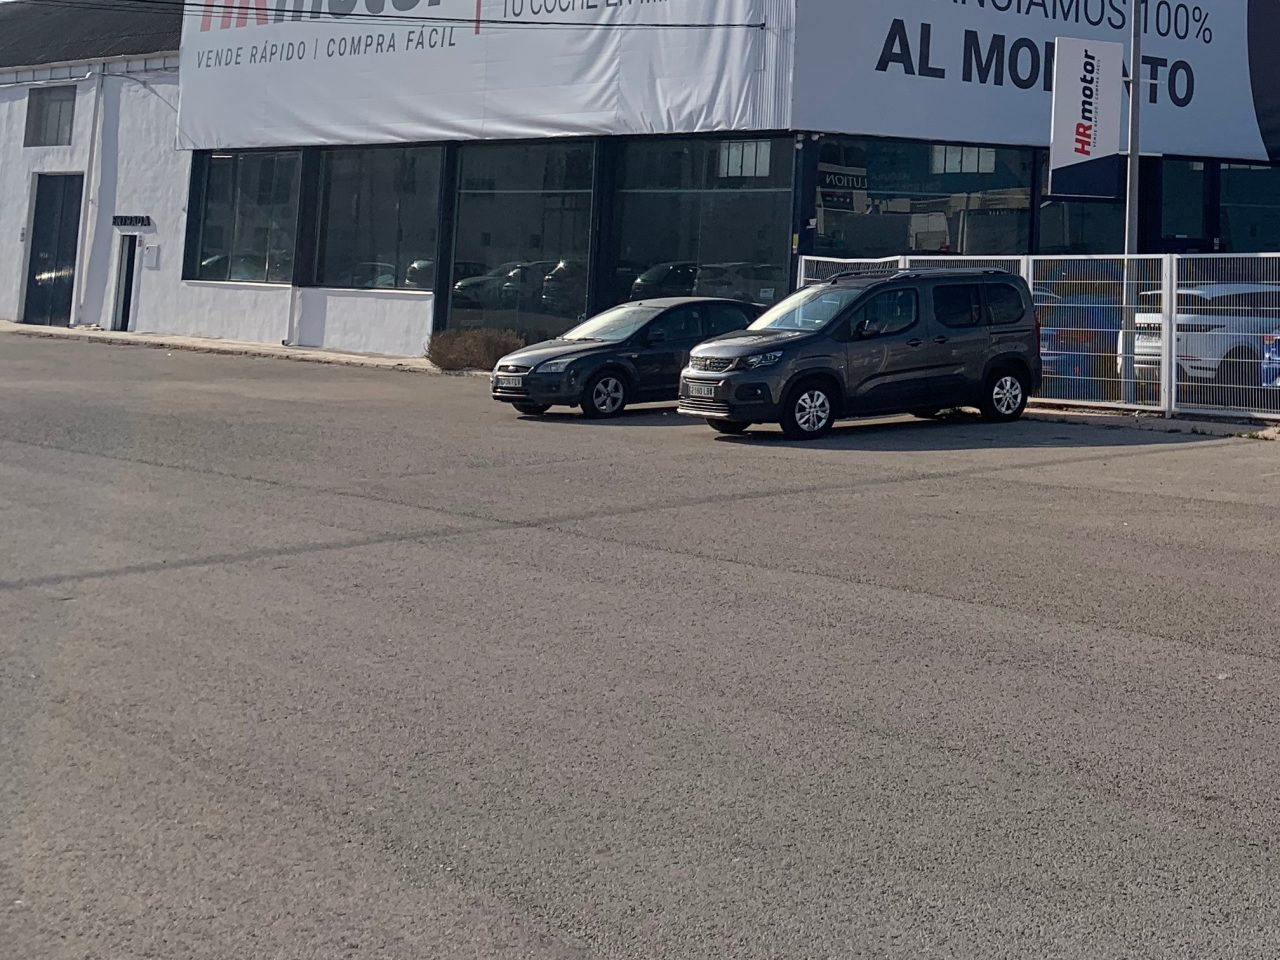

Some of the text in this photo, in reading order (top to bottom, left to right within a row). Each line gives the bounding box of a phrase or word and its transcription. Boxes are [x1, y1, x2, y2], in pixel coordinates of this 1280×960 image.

[197, 24, 456, 69] VENDE RÁPIDO COMPRA FÁCIL
[875, 18, 1195, 108] AL MOTO
[1074, 48, 1096, 156] HRmotor
[112, 215, 150, 227] ENTRADA
